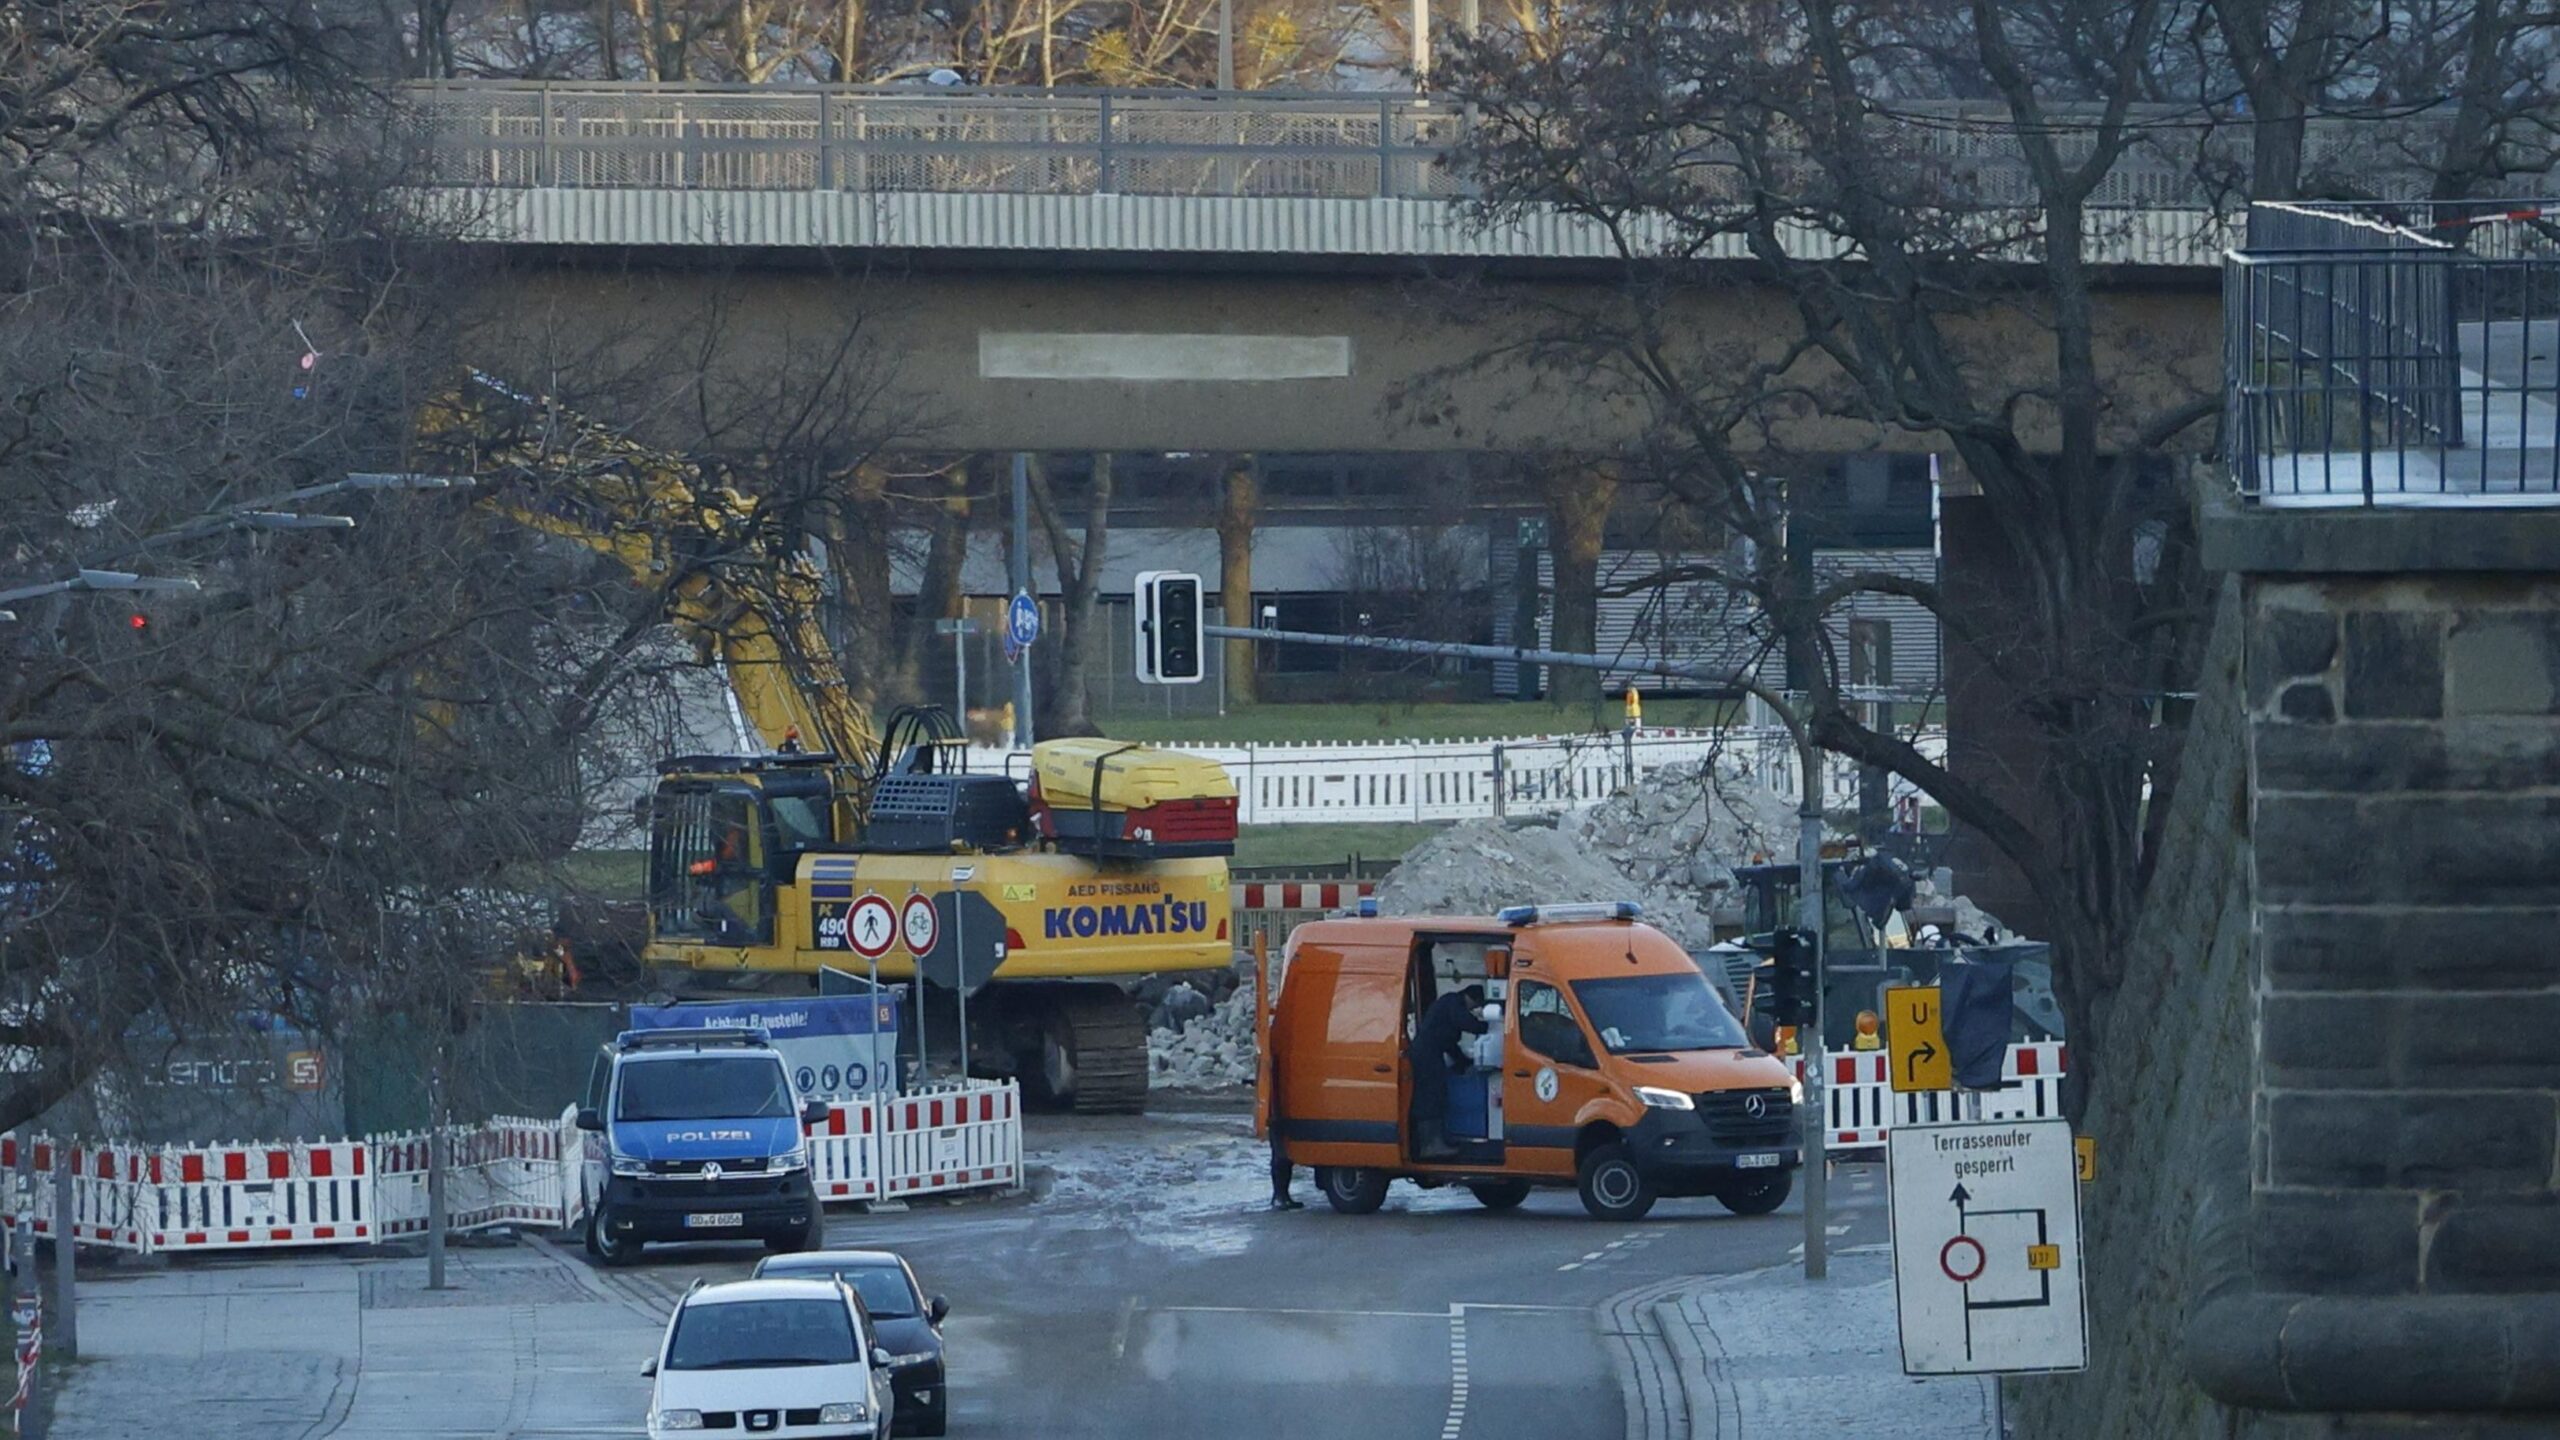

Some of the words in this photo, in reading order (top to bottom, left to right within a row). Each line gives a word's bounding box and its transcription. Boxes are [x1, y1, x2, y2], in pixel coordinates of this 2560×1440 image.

[1068, 885, 1096, 897] AED
[819, 917, 847, 936] 490
[1045, 893, 1207, 939] KOMATSU
[666, 1130, 751, 1143] POLIZEI
[1932, 1128, 2032, 1151] Terrassenufer
[1954, 1155, 2015, 1179] gesperrt
